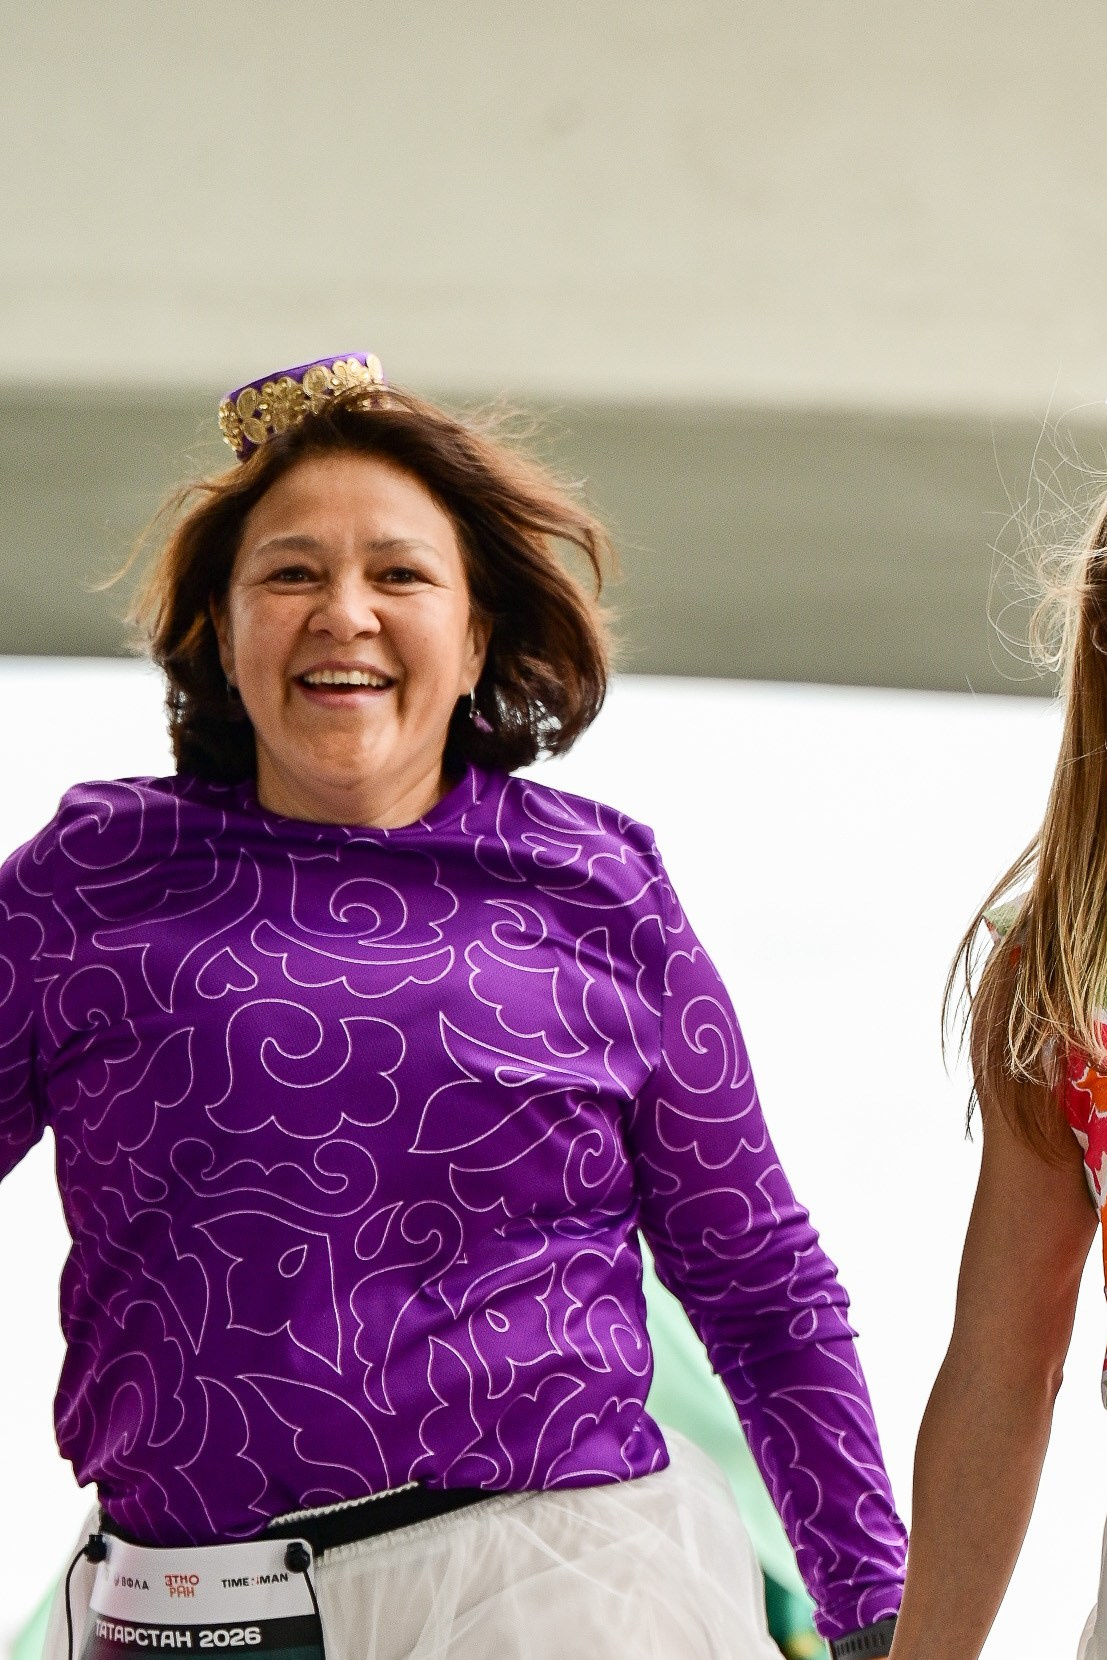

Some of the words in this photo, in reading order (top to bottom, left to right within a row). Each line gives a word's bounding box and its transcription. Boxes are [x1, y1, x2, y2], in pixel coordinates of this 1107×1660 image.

[164, 1574, 200, 1587] ЭТНО
[169, 1585, 195, 1598] РАН
[96, 1620, 192, 1648] ТАТАРСТАН
[199, 1627, 262, 1648] 2026
